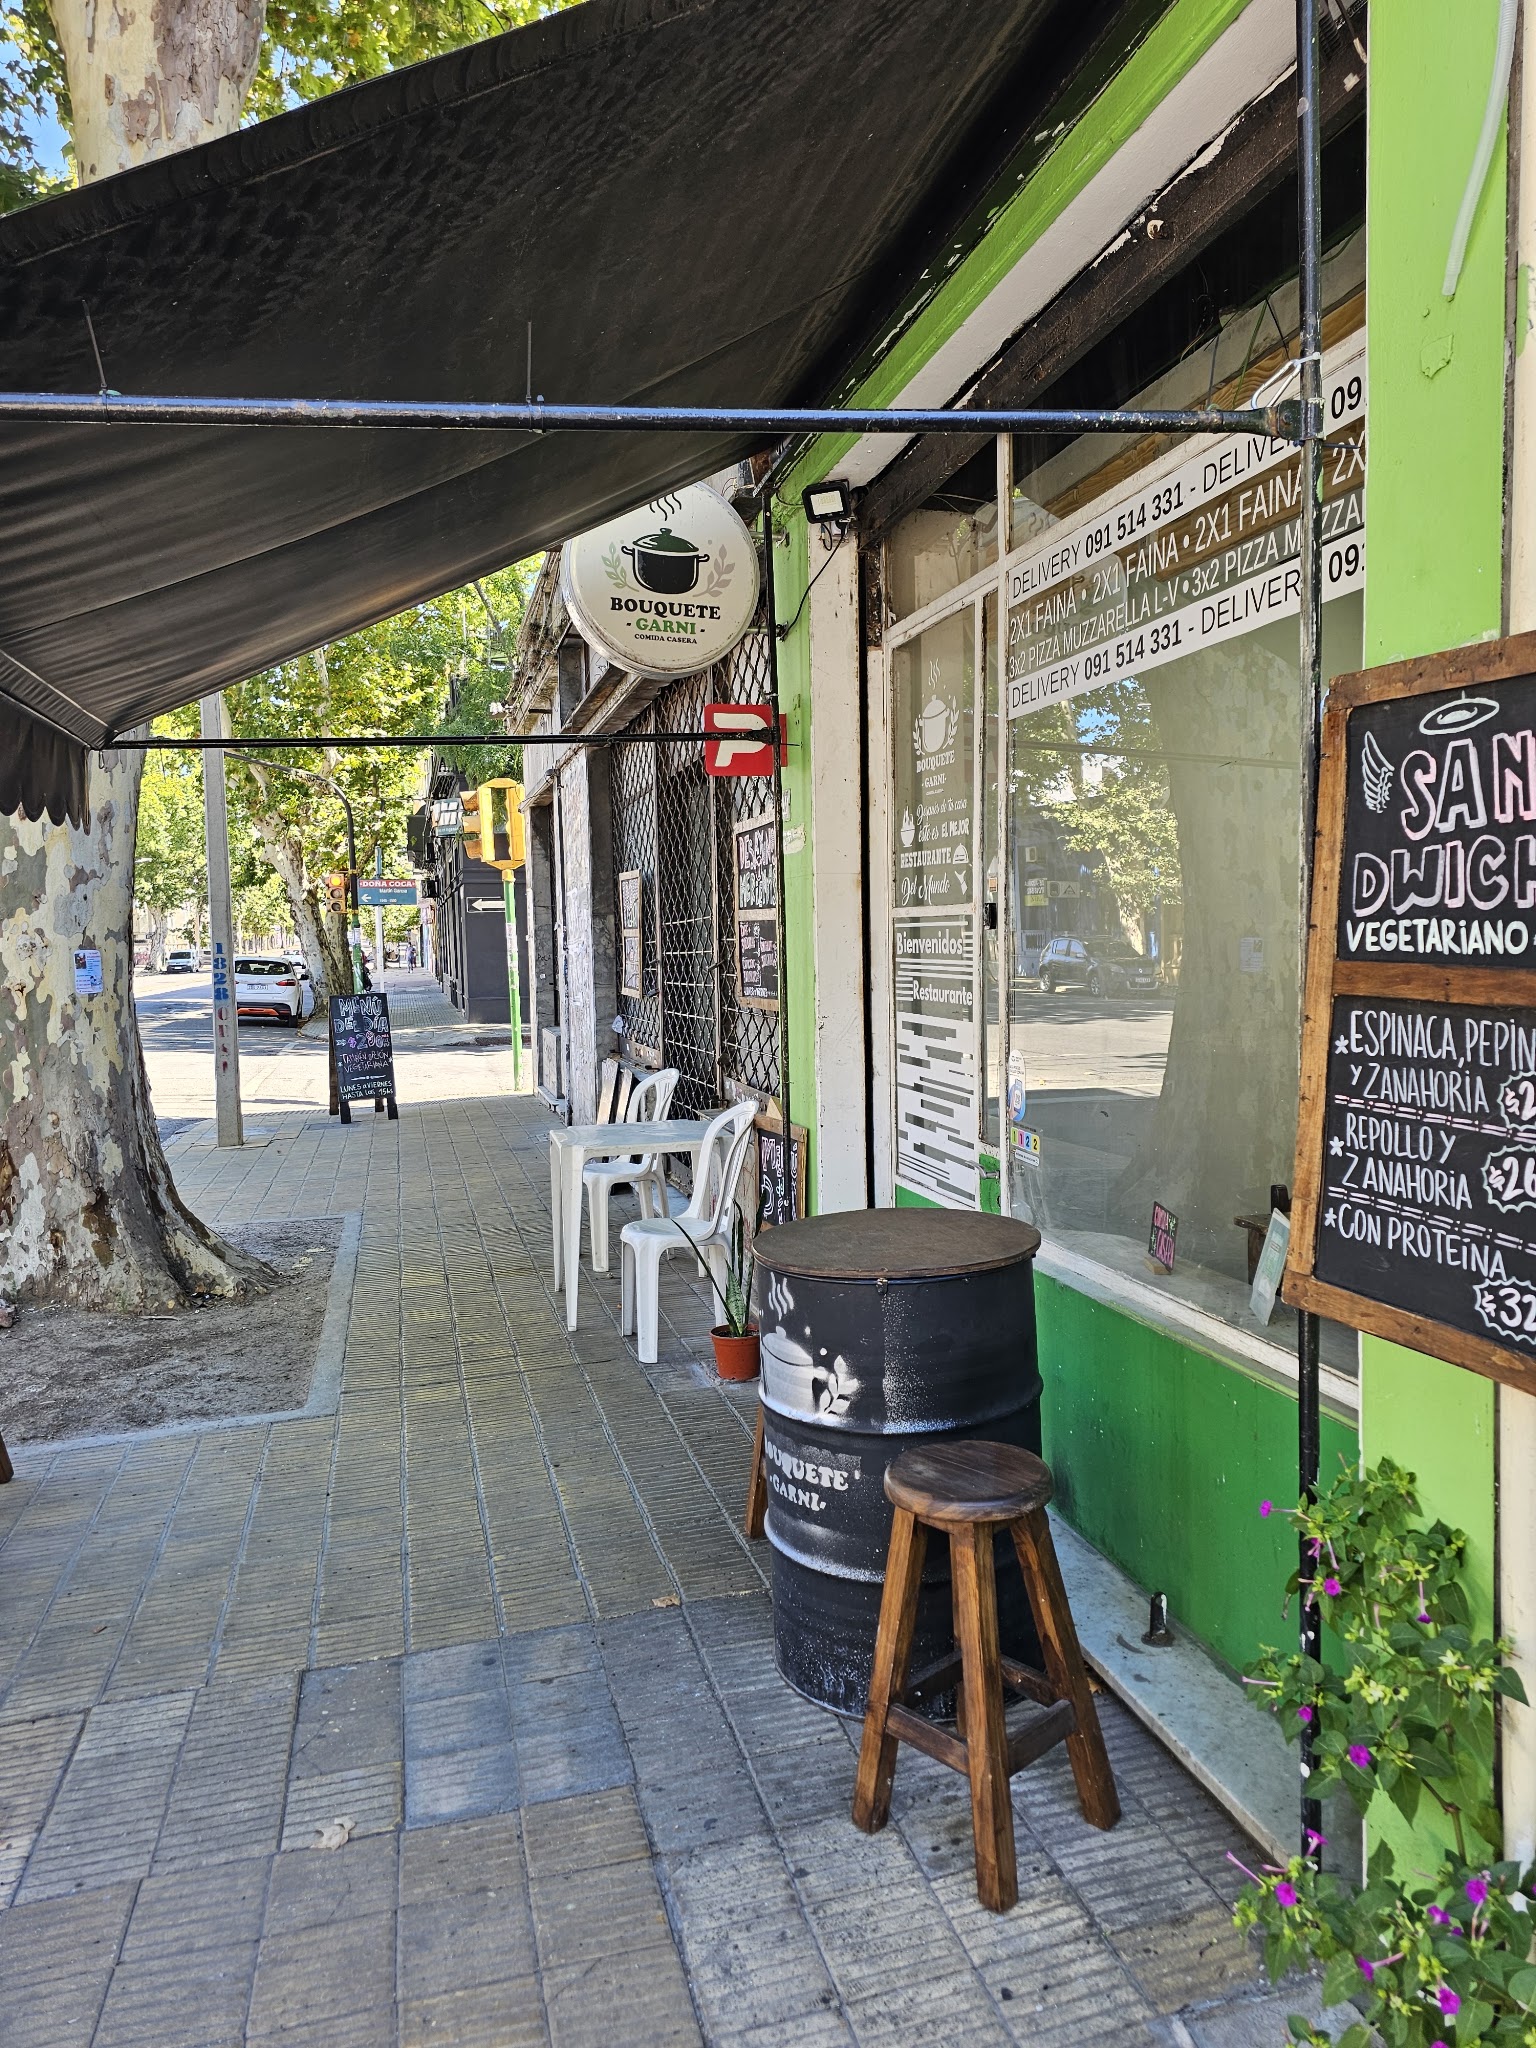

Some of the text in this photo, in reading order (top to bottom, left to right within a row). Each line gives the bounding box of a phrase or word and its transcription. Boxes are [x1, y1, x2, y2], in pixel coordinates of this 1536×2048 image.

[1013, 540, 1081, 599] DELIVERY
[1085, 523, 1112, 558] 091
[1117, 503, 1147, 540] 514
[1151, 482, 1184, 521] 331
[1009, 609, 1032, 646] 2X1
[1035, 586, 1077, 633] FAINA
[1092, 562, 1121, 605] 2X1
[1125, 532, 1179, 588] FAINA
[1195, 502, 1232, 554] 2X1
[610, 597, 721, 620] BOUQUETE
[1009, 651, 1026, 679] 3x2
[1028, 635, 1060, 670] PIZZA
[1063, 592, 1151, 655] MUZZARELLA
[1154, 577, 1179, 614] L-V
[1191, 558, 1220, 597] 3x2
[1225, 531, 1279, 583] PIZZA
[635, 617, 697, 635] GARNI
[634, 633, 698, 645] COMIDA CASERA
[1012, 661, 1080, 709] DELIVERY
[1084, 649, 1111, 681] 091
[1115, 634, 1146, 669] 514
[1150, 619, 1182, 655] 331
[1201, 569, 1301, 635] DELIVER
[916, 750, 955, 773] BOUQUETE
[924, 773, 946, 788] GARNI
[941, 821, 949, 838] EL
[949, 817, 970, 837] MEJOR
[900, 847, 952, 869] RESTAURANTE
[901, 872, 950, 906] Del Mundo
[896, 929, 963, 955] Bienvenidos
[913, 979, 973, 1006] Restaurante
[339, 996, 382, 1017] MENÚ
[334, 1016, 361, 1034] DEL
[340, 1084, 362, 1093] LUNES
[367, 1080, 392, 1089] VIERNES
[342, 1091, 363, 1100] HASTA
[1346, 1112, 1433, 1162] REPOLLO
[1338, 1203, 1382, 1247] CON
[772, 1474, 819, 1511] GARNI
